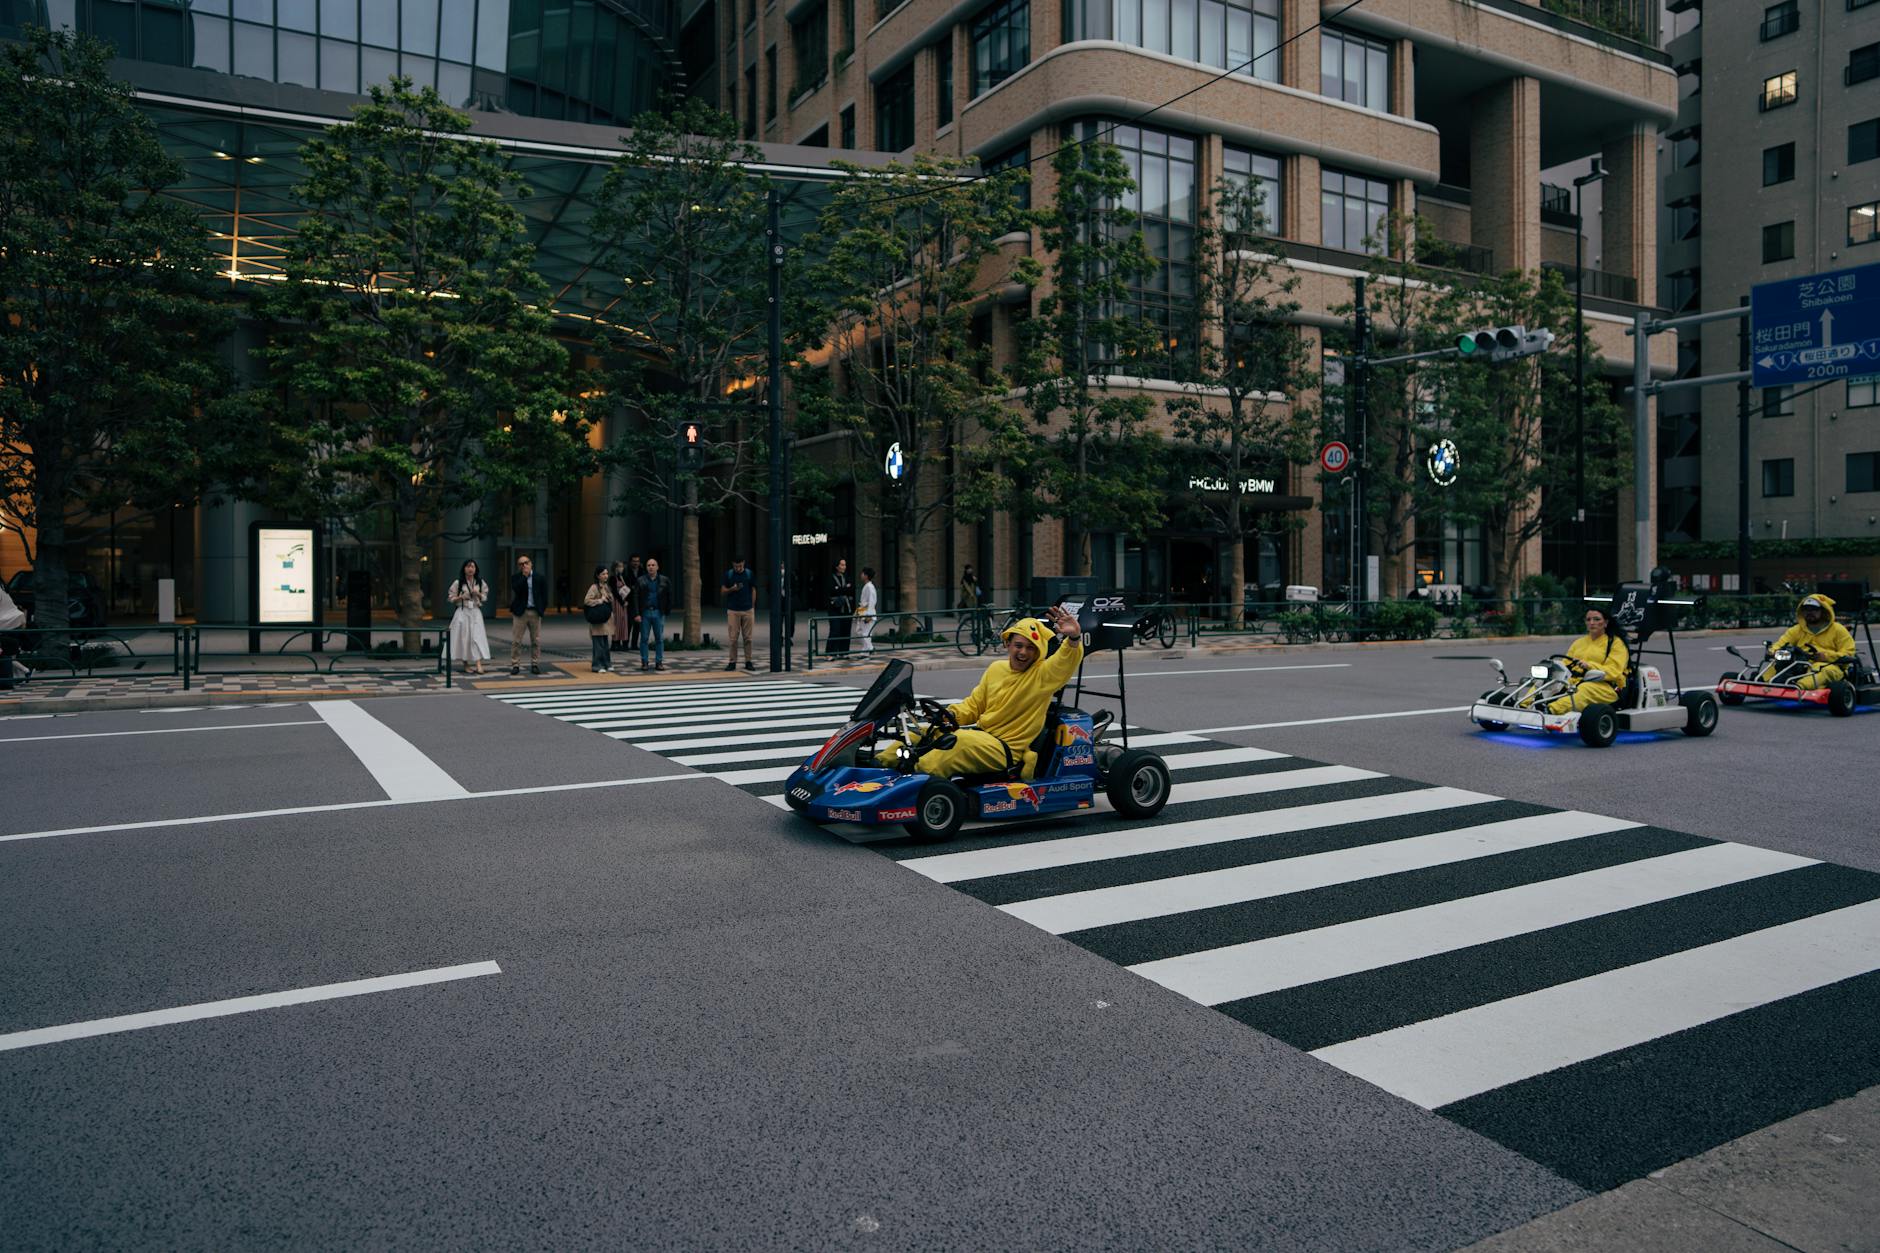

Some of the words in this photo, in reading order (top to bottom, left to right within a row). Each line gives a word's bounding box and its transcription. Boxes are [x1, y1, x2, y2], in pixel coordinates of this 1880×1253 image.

[1798, 274, 1856, 299] 芝公園
[1801, 294, 1853, 309] Shibakoen
[1756, 321, 1811, 343] 桜田門
[1754, 339, 1813, 353] Sakuradamon
[1870, 342, 1876, 353] 1
[1779, 355, 1785, 365] 1
[1807, 364, 1849, 378] 200m
[1327, 450, 1343, 464] 40
[1248, 478, 1275, 493] BMW
[815, 533, 828, 544] BMW
[1048, 784, 1069, 792] Audi
[1070, 781, 1093, 792] Sport
[983, 801, 1000, 813] Red
[1000, 799, 1017, 811] Bull
[879, 810, 917, 820] TOTAL
